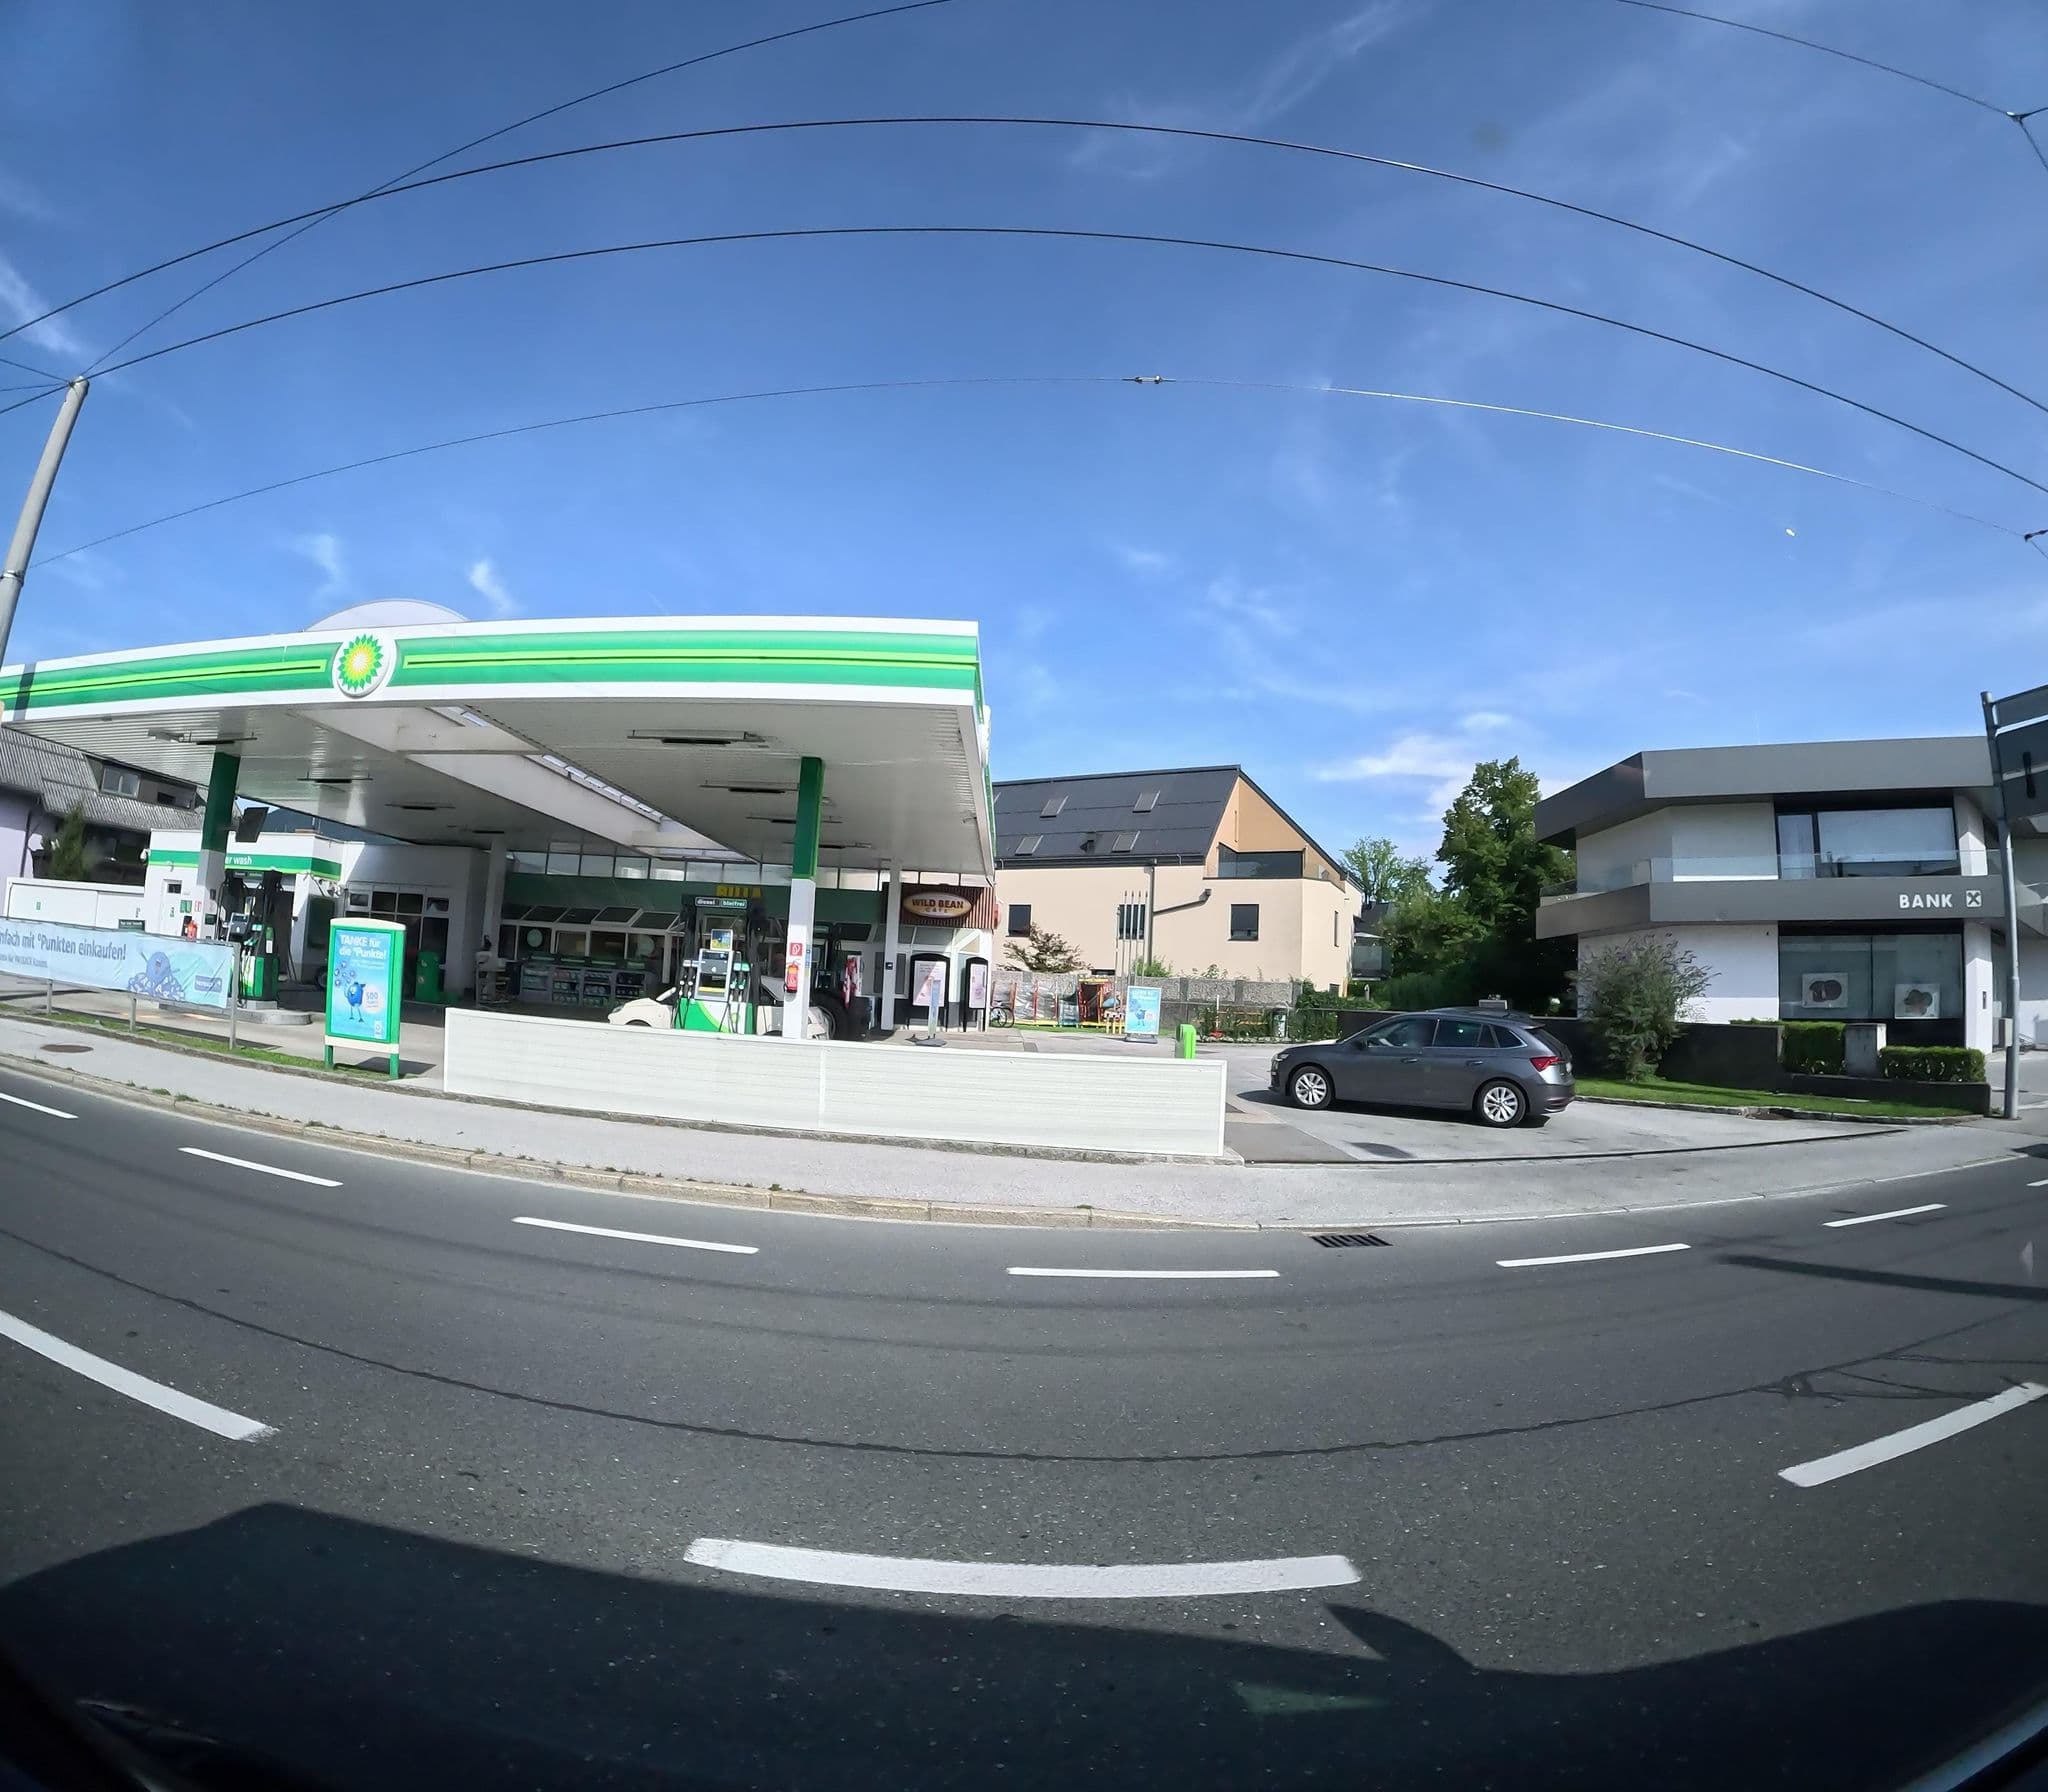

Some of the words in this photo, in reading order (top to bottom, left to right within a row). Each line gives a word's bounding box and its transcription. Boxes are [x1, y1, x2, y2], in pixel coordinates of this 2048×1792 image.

[233, 856, 252, 864] wash
[912, 899, 936, 907] WILD
[938, 900, 964, 909] BEAN
[1899, 893, 1953, 908] BANK
[22, 932, 35, 949] mit
[78, 939, 127, 960] einkaufen!
[340, 935, 368, 946] TANKE
